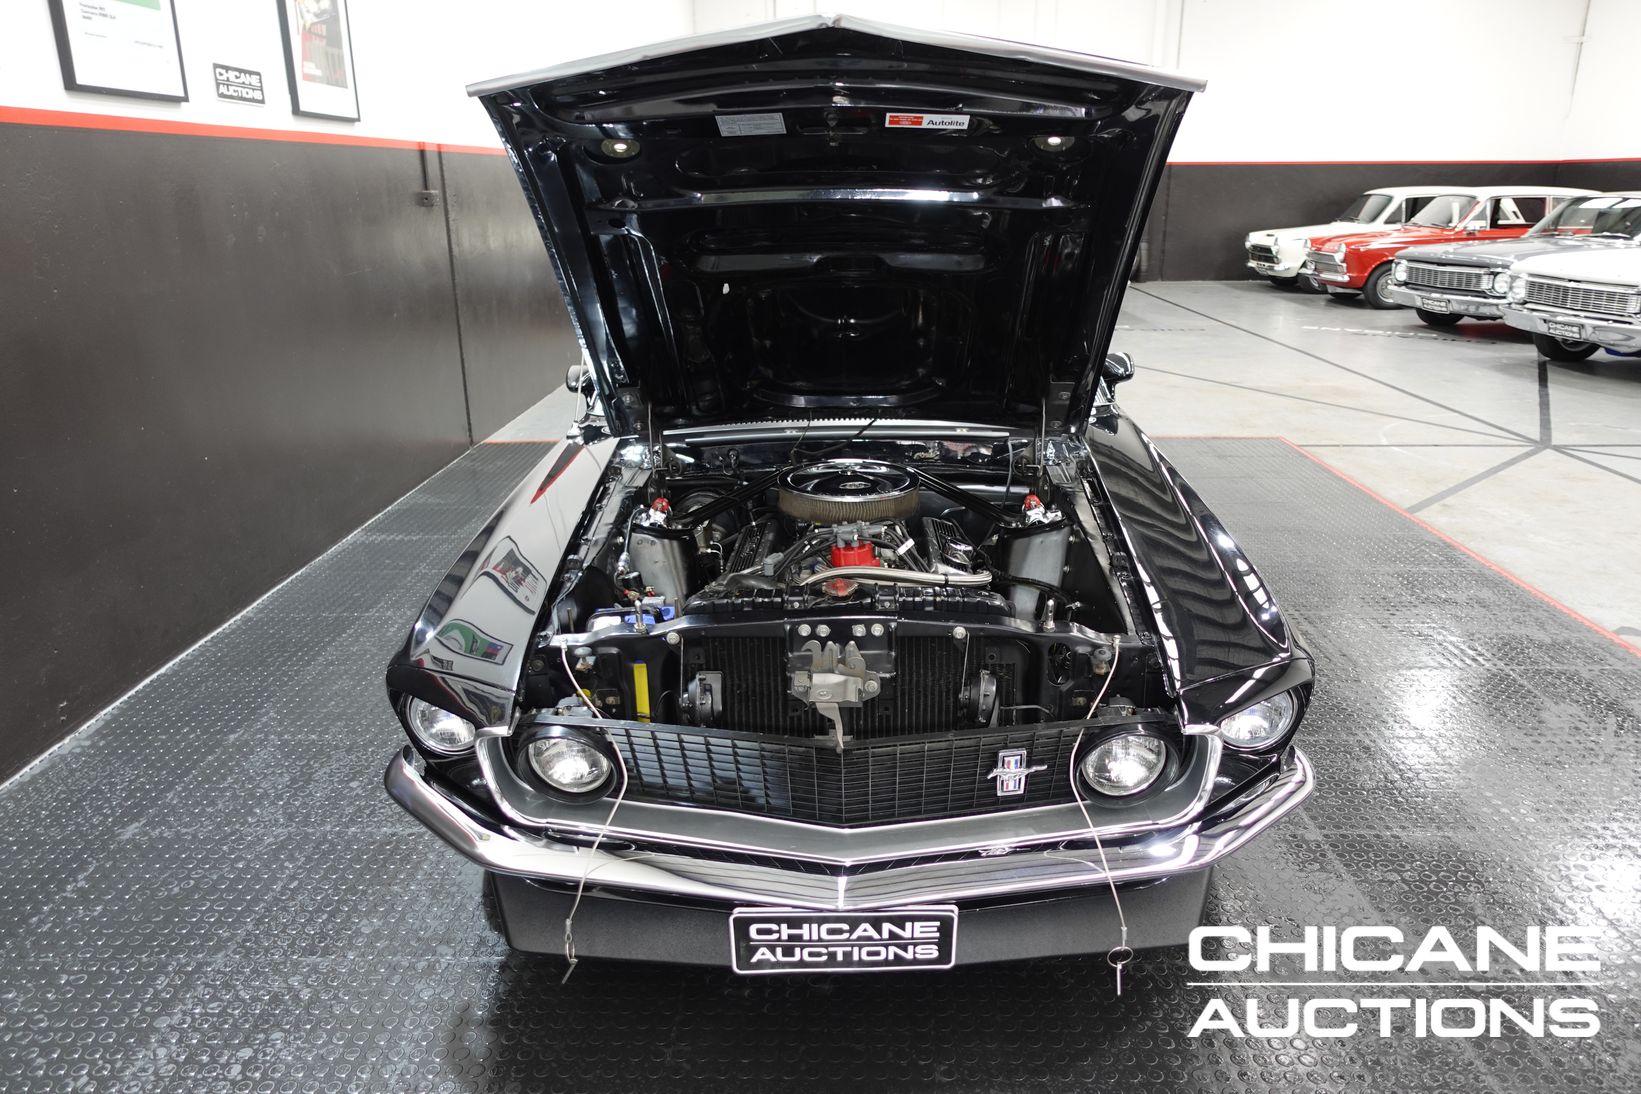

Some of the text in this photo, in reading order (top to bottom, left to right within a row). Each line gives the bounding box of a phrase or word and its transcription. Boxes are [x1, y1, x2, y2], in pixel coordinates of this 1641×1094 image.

[215, 68, 261, 86] CHICANE
[218, 84, 263, 100] AUCTIONS
[927, 119, 965, 127] Autolite
[1549, 322, 1580, 333] CHICANE
[749, 921, 941, 940] CHICANE
[750, 945, 939, 962] AUCTIONS
